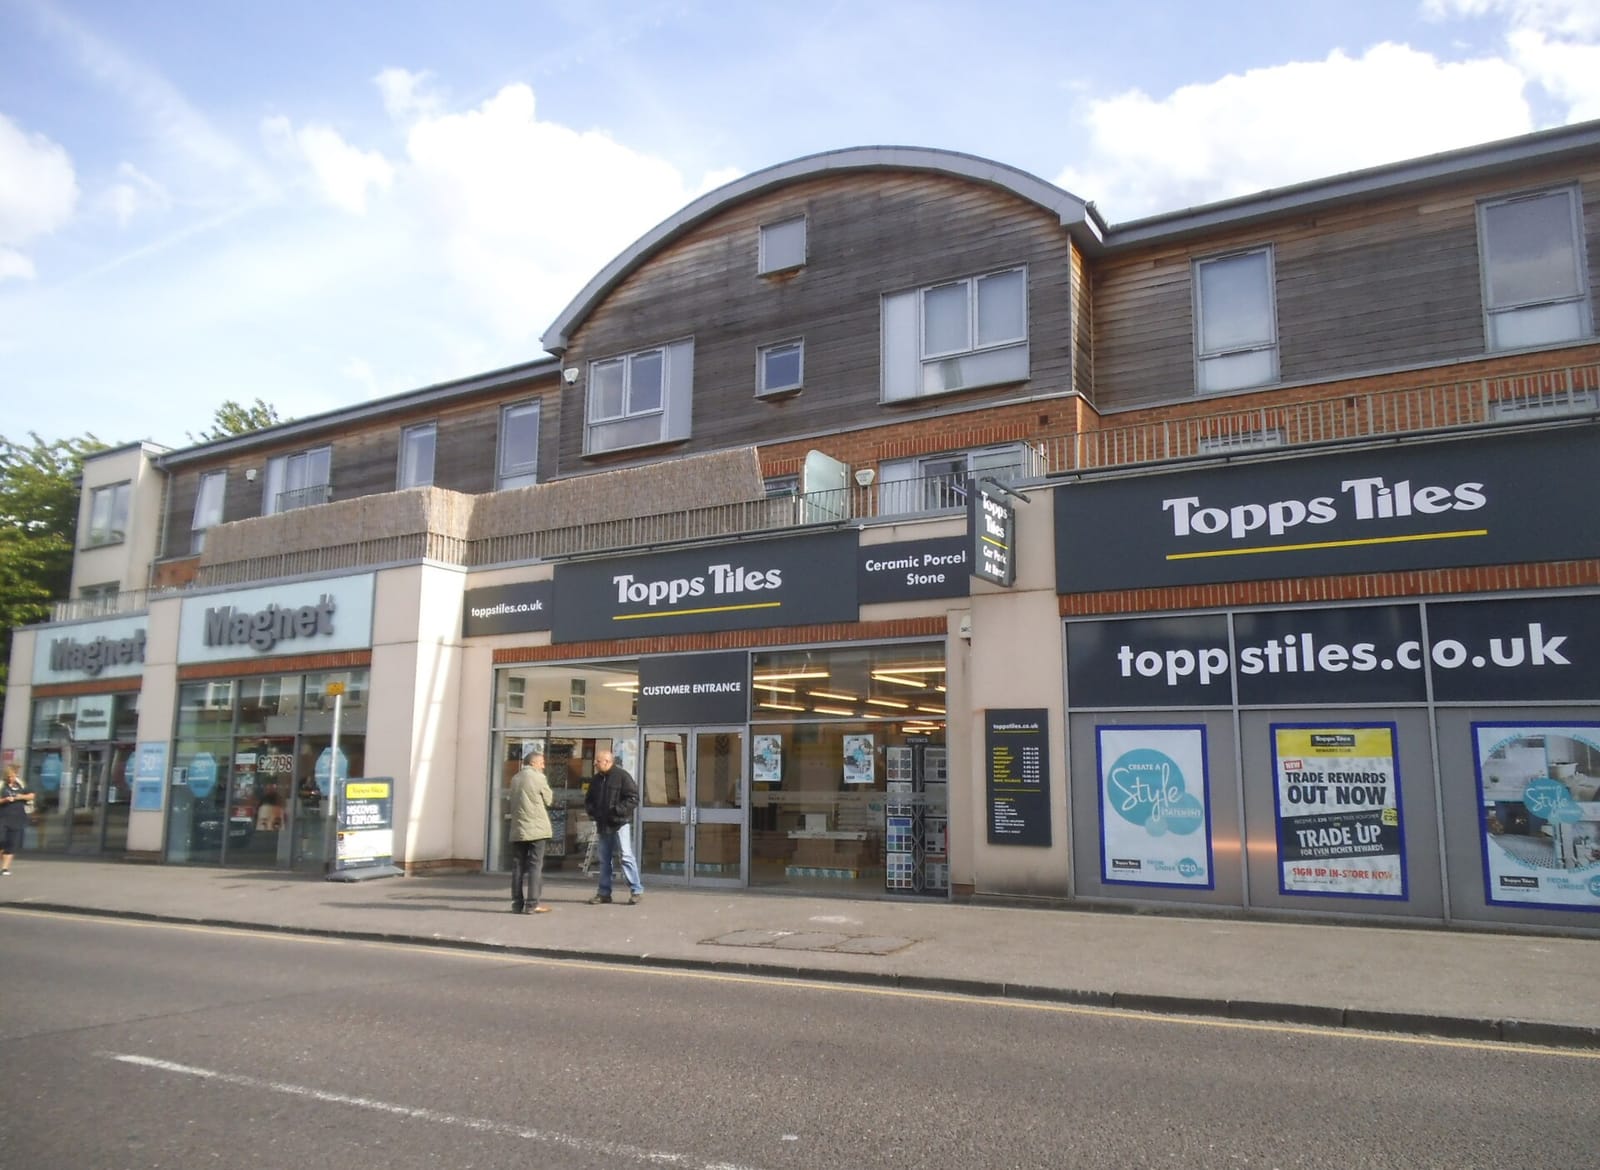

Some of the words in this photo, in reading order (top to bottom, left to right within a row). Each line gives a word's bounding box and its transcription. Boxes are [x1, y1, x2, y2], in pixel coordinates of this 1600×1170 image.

[981, 490, 1008, 519] Topps
[1162, 496, 1338, 539] Topps
[1341, 476, 1487, 520] Tiles
[985, 514, 1005, 538] Tiles
[865, 555, 920, 573] Ceramic
[923, 550, 966, 571] Porcel
[612, 574, 706, 606] Topps
[708, 563, 783, 595] Tiles
[906, 572, 945, 586] Stone
[471, 599, 543, 619] toppstiles.co.uk
[203, 593, 337, 653] Magnet
[49, 628, 148, 676] Magnet
[1117, 622, 1572, 687] toppstiles.co.uk
[642, 684, 691, 697] CUSTOMER
[693, 682, 741, 695] ENTRANCE
[257, 754, 293, 773] £2798
[1285, 761, 1301, 769] NEW
[1286, 772, 1324, 784] TRADE
[1329, 772, 1386, 784] REWARDS
[1112, 762, 1183, 822] Style
[1287, 785, 1328, 805] OUT
[1336, 786, 1387, 805] NOW
[1296, 827, 1353, 848] TRADE
[1355, 823, 1381, 845] UP
[1300, 848, 1313, 857] FOR
[1314, 847, 1330, 856] EVEN
[1330, 846, 1353, 855] RICHER
[1354, 843, 1384, 853] REWARDS
[1292, 867, 1312, 877] SIGN
[1315, 868, 1327, 877] UP
[1329, 869, 1368, 879] IN-STORE
